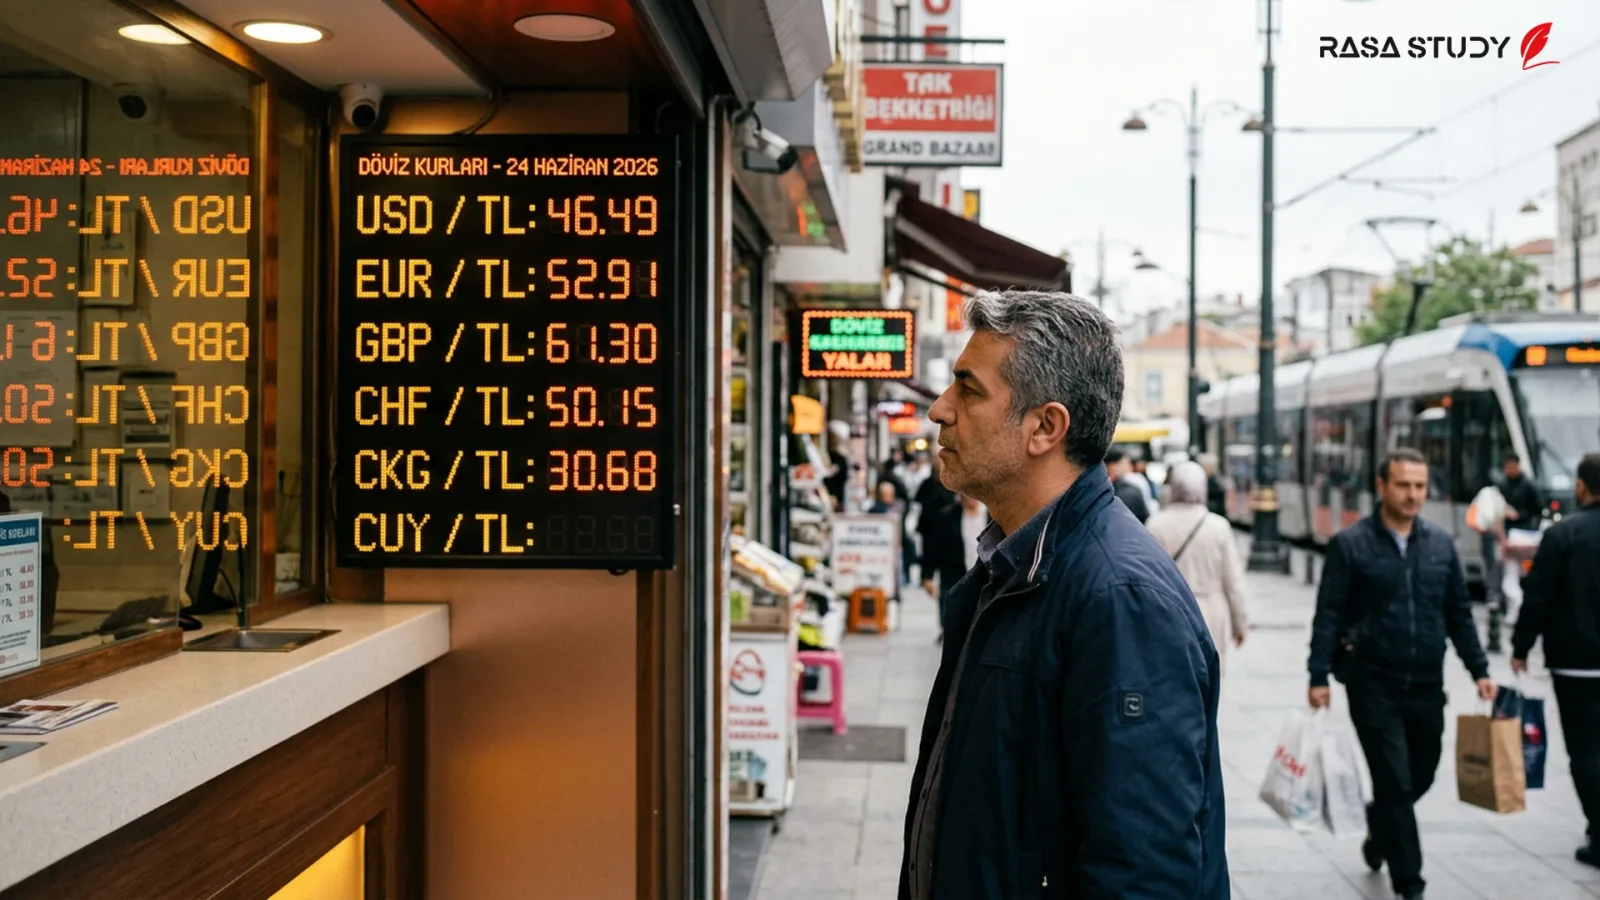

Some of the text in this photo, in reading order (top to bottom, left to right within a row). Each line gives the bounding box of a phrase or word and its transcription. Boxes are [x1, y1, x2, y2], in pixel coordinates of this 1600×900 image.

[358, 152, 411, 176] DÖVİZ
[414, 157, 488, 176] KURLARI
[506, 157, 529, 176] 24
[534, 153, 609, 176] HAZİRAN
[612, 157, 659, 176] 2026
[865, 139, 923, 155] GRAND
[357, 195, 658, 235] USD / TL: 46.49
[356, 259, 657, 299] EUR / TL: 52.91
[356, 322, 657, 363] GBP / TL: 61.30
[355, 386, 657, 427] CHF / TL: 50.15
[355, 450, 657, 491] CKG / TL: 30.68
[354, 513, 430, 553] CUY
[444, 513, 463, 553] /
[475, 513, 534, 553] TL:
